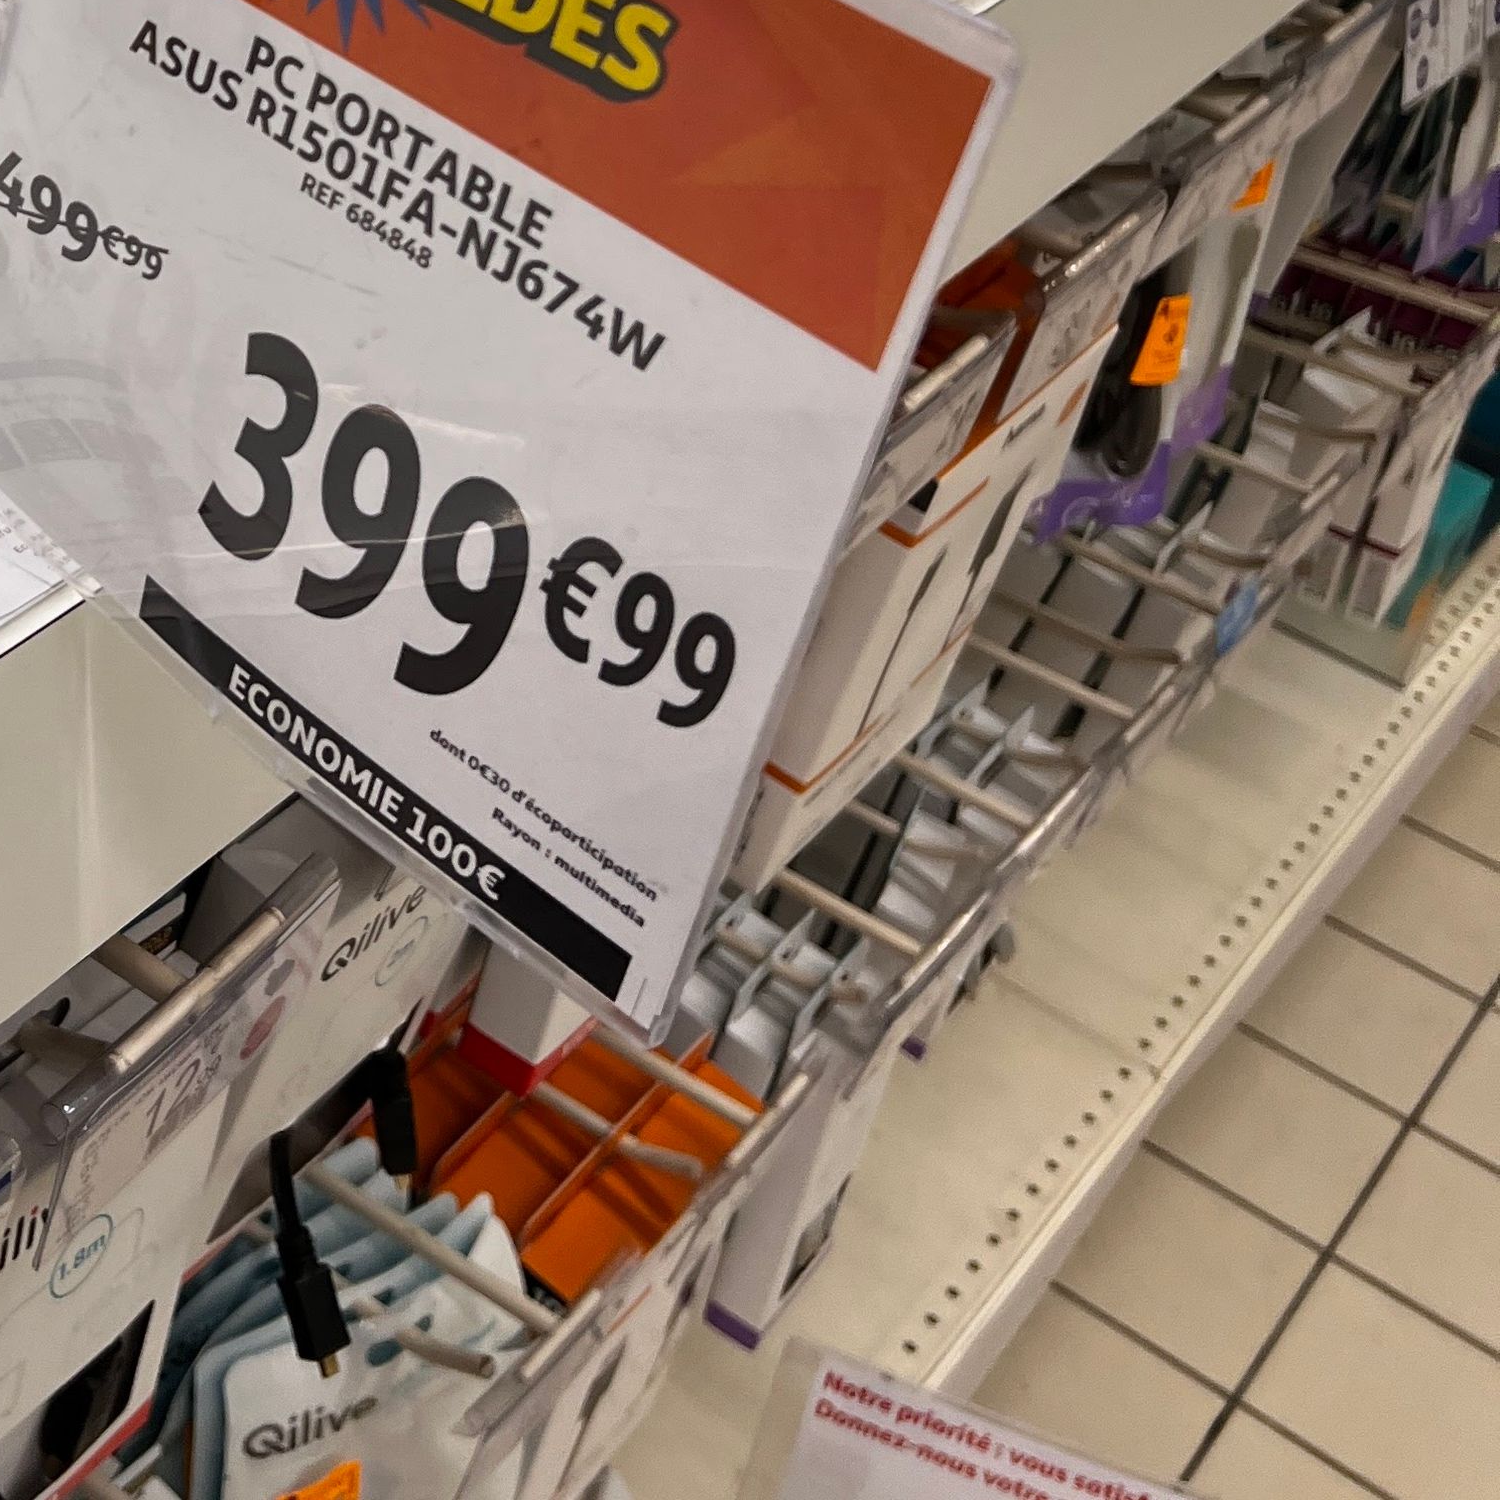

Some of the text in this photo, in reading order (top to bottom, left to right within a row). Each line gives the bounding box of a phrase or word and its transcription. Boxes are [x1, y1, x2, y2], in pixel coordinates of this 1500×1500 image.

[128, 19, 668, 374] ASUS R1501FA-NJ674W
[242, 35, 555, 251] PC PORTABLE
[299, 172, 436, 272] REF 684848
[197, 331, 737, 729] 399€99
[228, 662, 507, 901] ECONOMIE 100€
[429, 728, 658, 902] dont 0€30 d'écoparticipation
[491, 806, 646, 929] Rayon multimedia
[320, 884, 427, 983] Qilive
[242, 1395, 380, 1460] Qilive
[814, 1397, 978, 1479] Donnez-nous
[823, 1369, 893, 1414] Notre
[894, 1402, 992, 1453] priorité
[1008, 1446, 1069, 1484] vous
